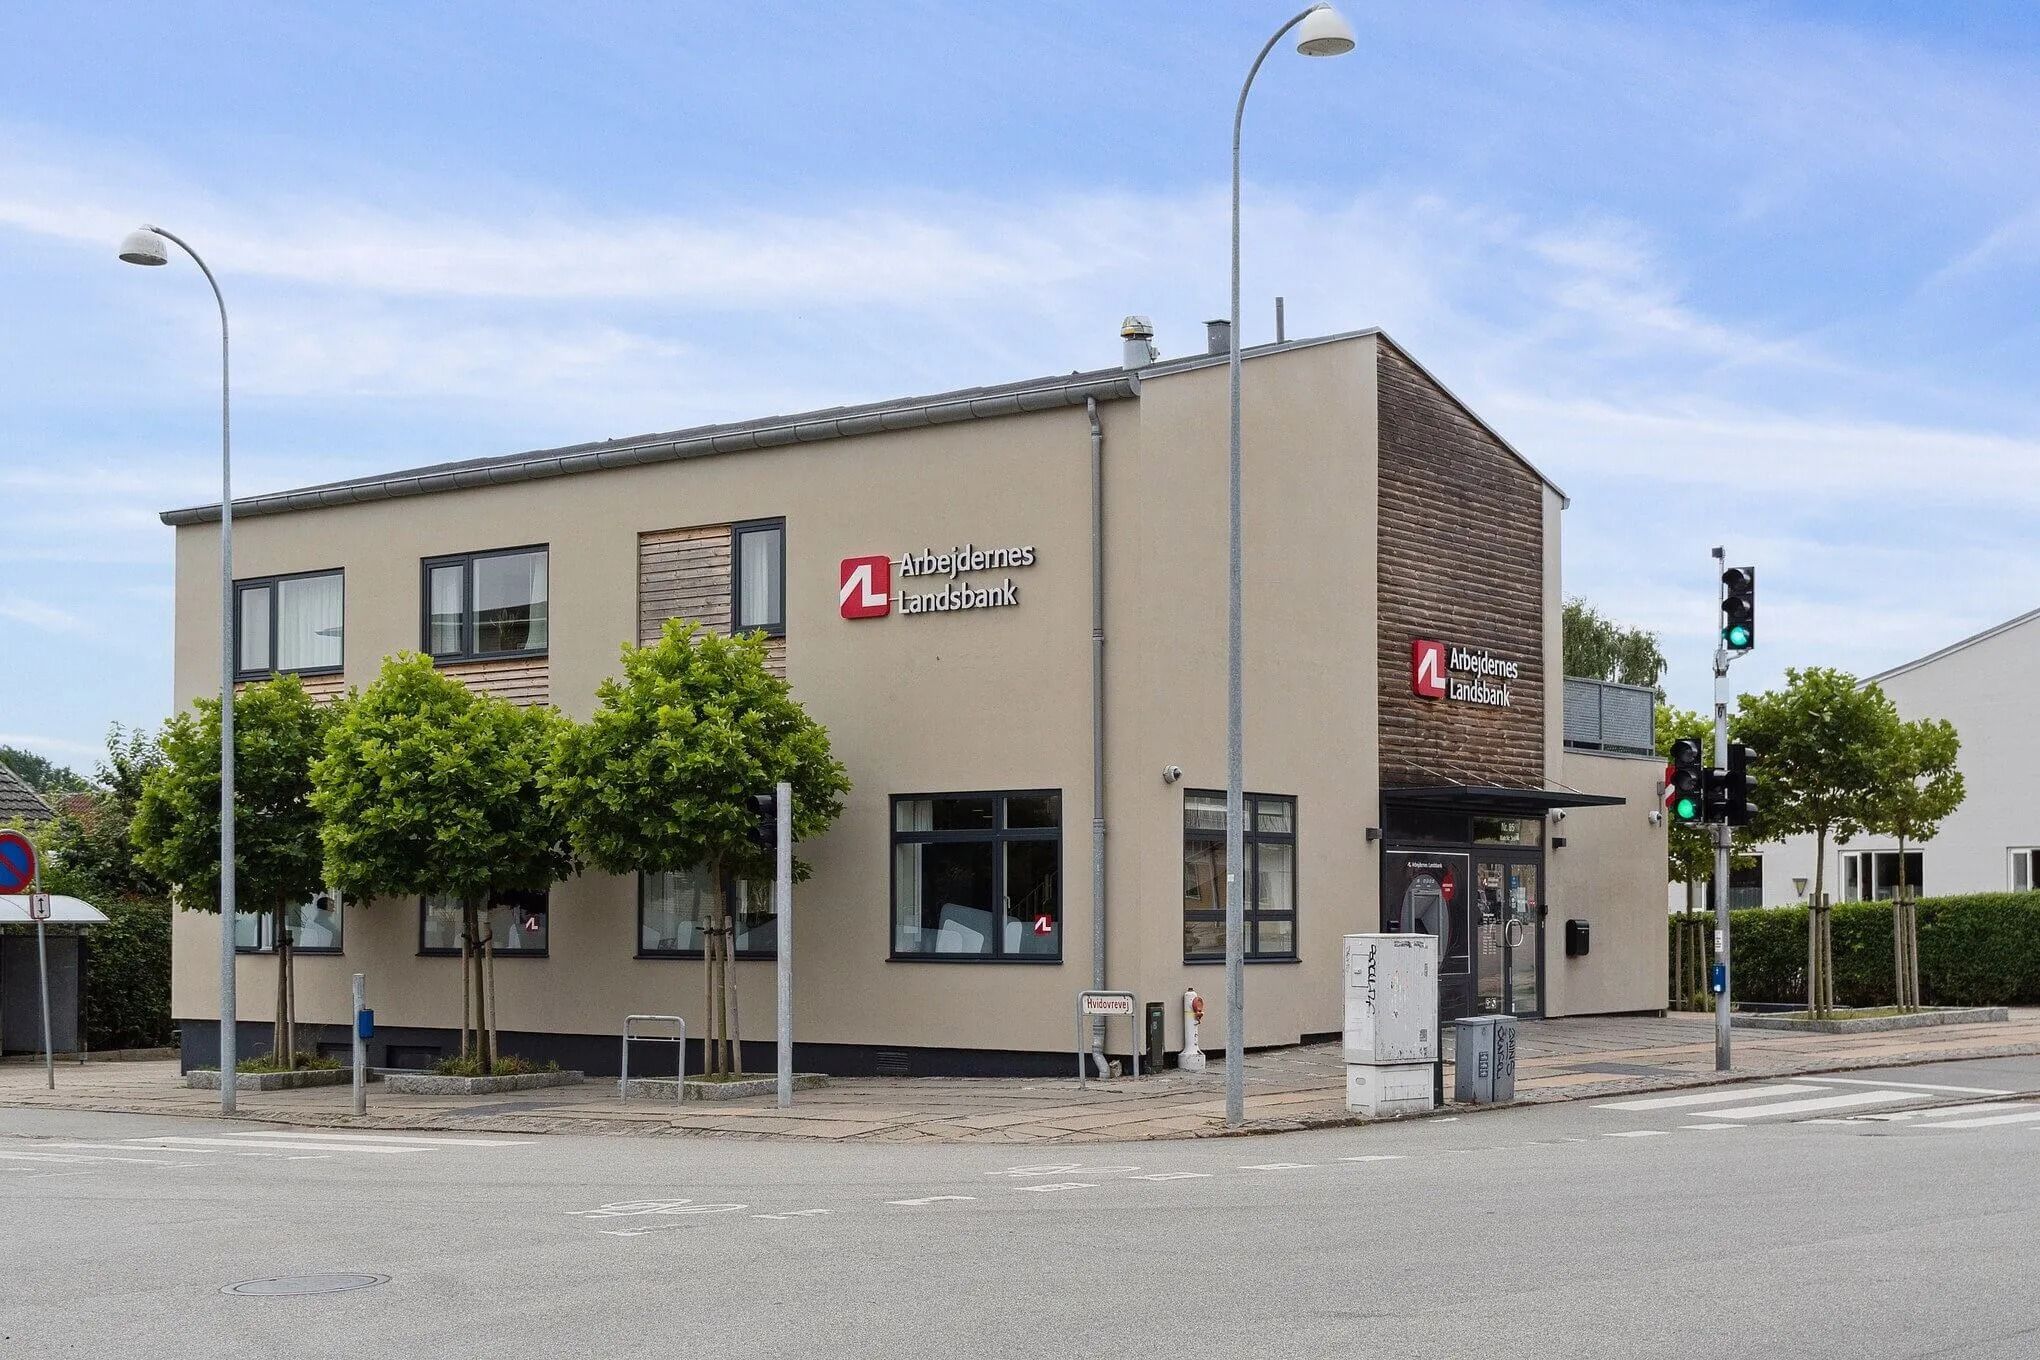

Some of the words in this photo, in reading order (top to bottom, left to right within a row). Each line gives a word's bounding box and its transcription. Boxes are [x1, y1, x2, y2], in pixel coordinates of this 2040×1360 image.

[900, 543, 1035, 580] Arbejdernes
[899, 579, 1017, 614] Landsbank
[1450, 647, 1518, 679] Arbejdernes
[1450, 677, 1510, 707] Landsbank
[1087, 998, 1129, 1011] Hvidovrevej
